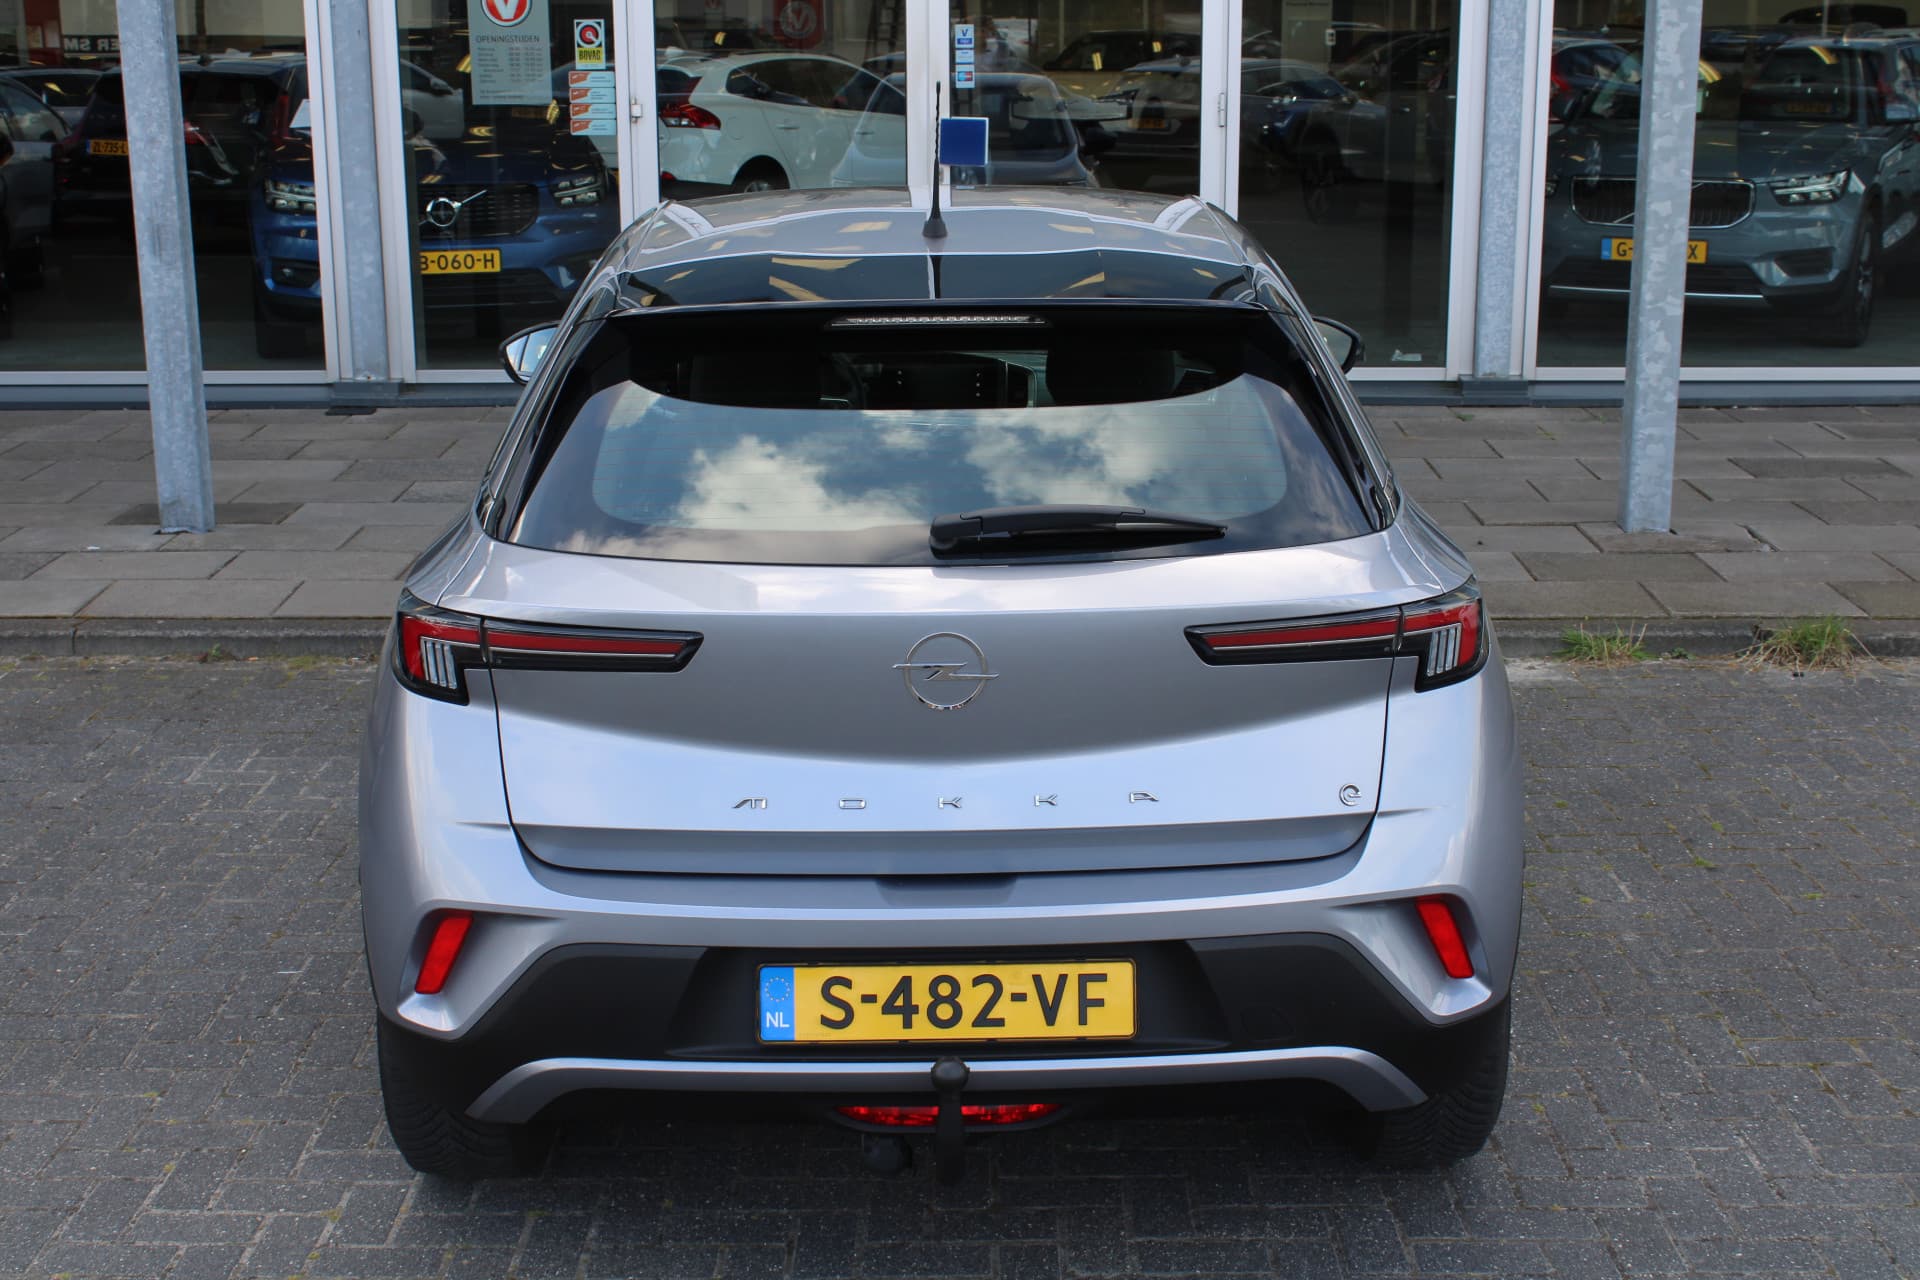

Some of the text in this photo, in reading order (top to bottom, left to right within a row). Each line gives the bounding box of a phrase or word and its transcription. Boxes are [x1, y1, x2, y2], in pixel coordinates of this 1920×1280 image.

[578, 49, 601, 61] BOVAG
[732, 791, 1159, 809] MOKKA
[820, 973, 1107, 1029] S-482-VF
[766, 1011, 790, 1028] NL
